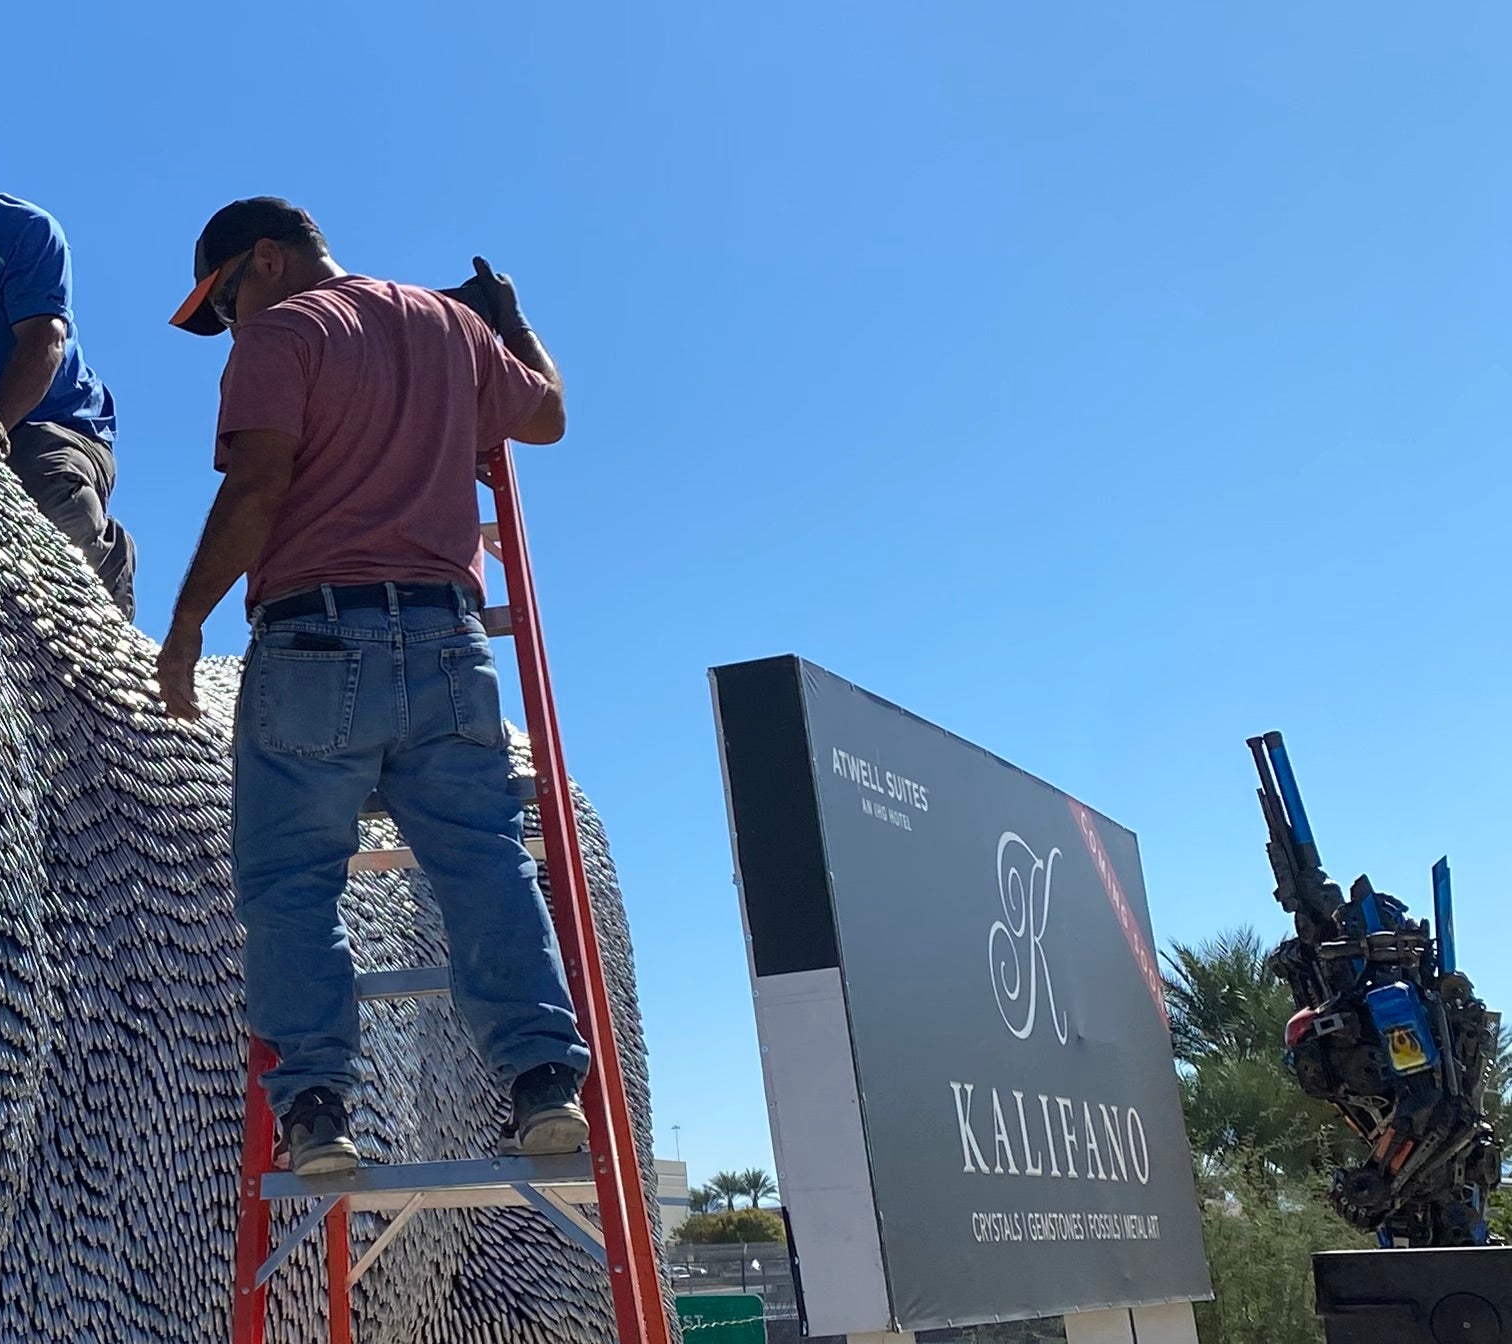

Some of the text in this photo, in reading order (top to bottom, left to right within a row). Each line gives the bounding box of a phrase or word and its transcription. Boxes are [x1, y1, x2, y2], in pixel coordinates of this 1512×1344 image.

[832, 746, 928, 812] ATWELL SUITES
[862, 797, 873, 816] AN
[888, 808, 913, 832] HOTEL
[1080, 811, 1129, 929] COMING
[950, 1080, 1150, 1185] KALIFANO
[972, 1212, 1161, 1242] CRYSTALS GEMSTONES FOSSILS METAL ART
[677, 1314, 704, 1329] ST
